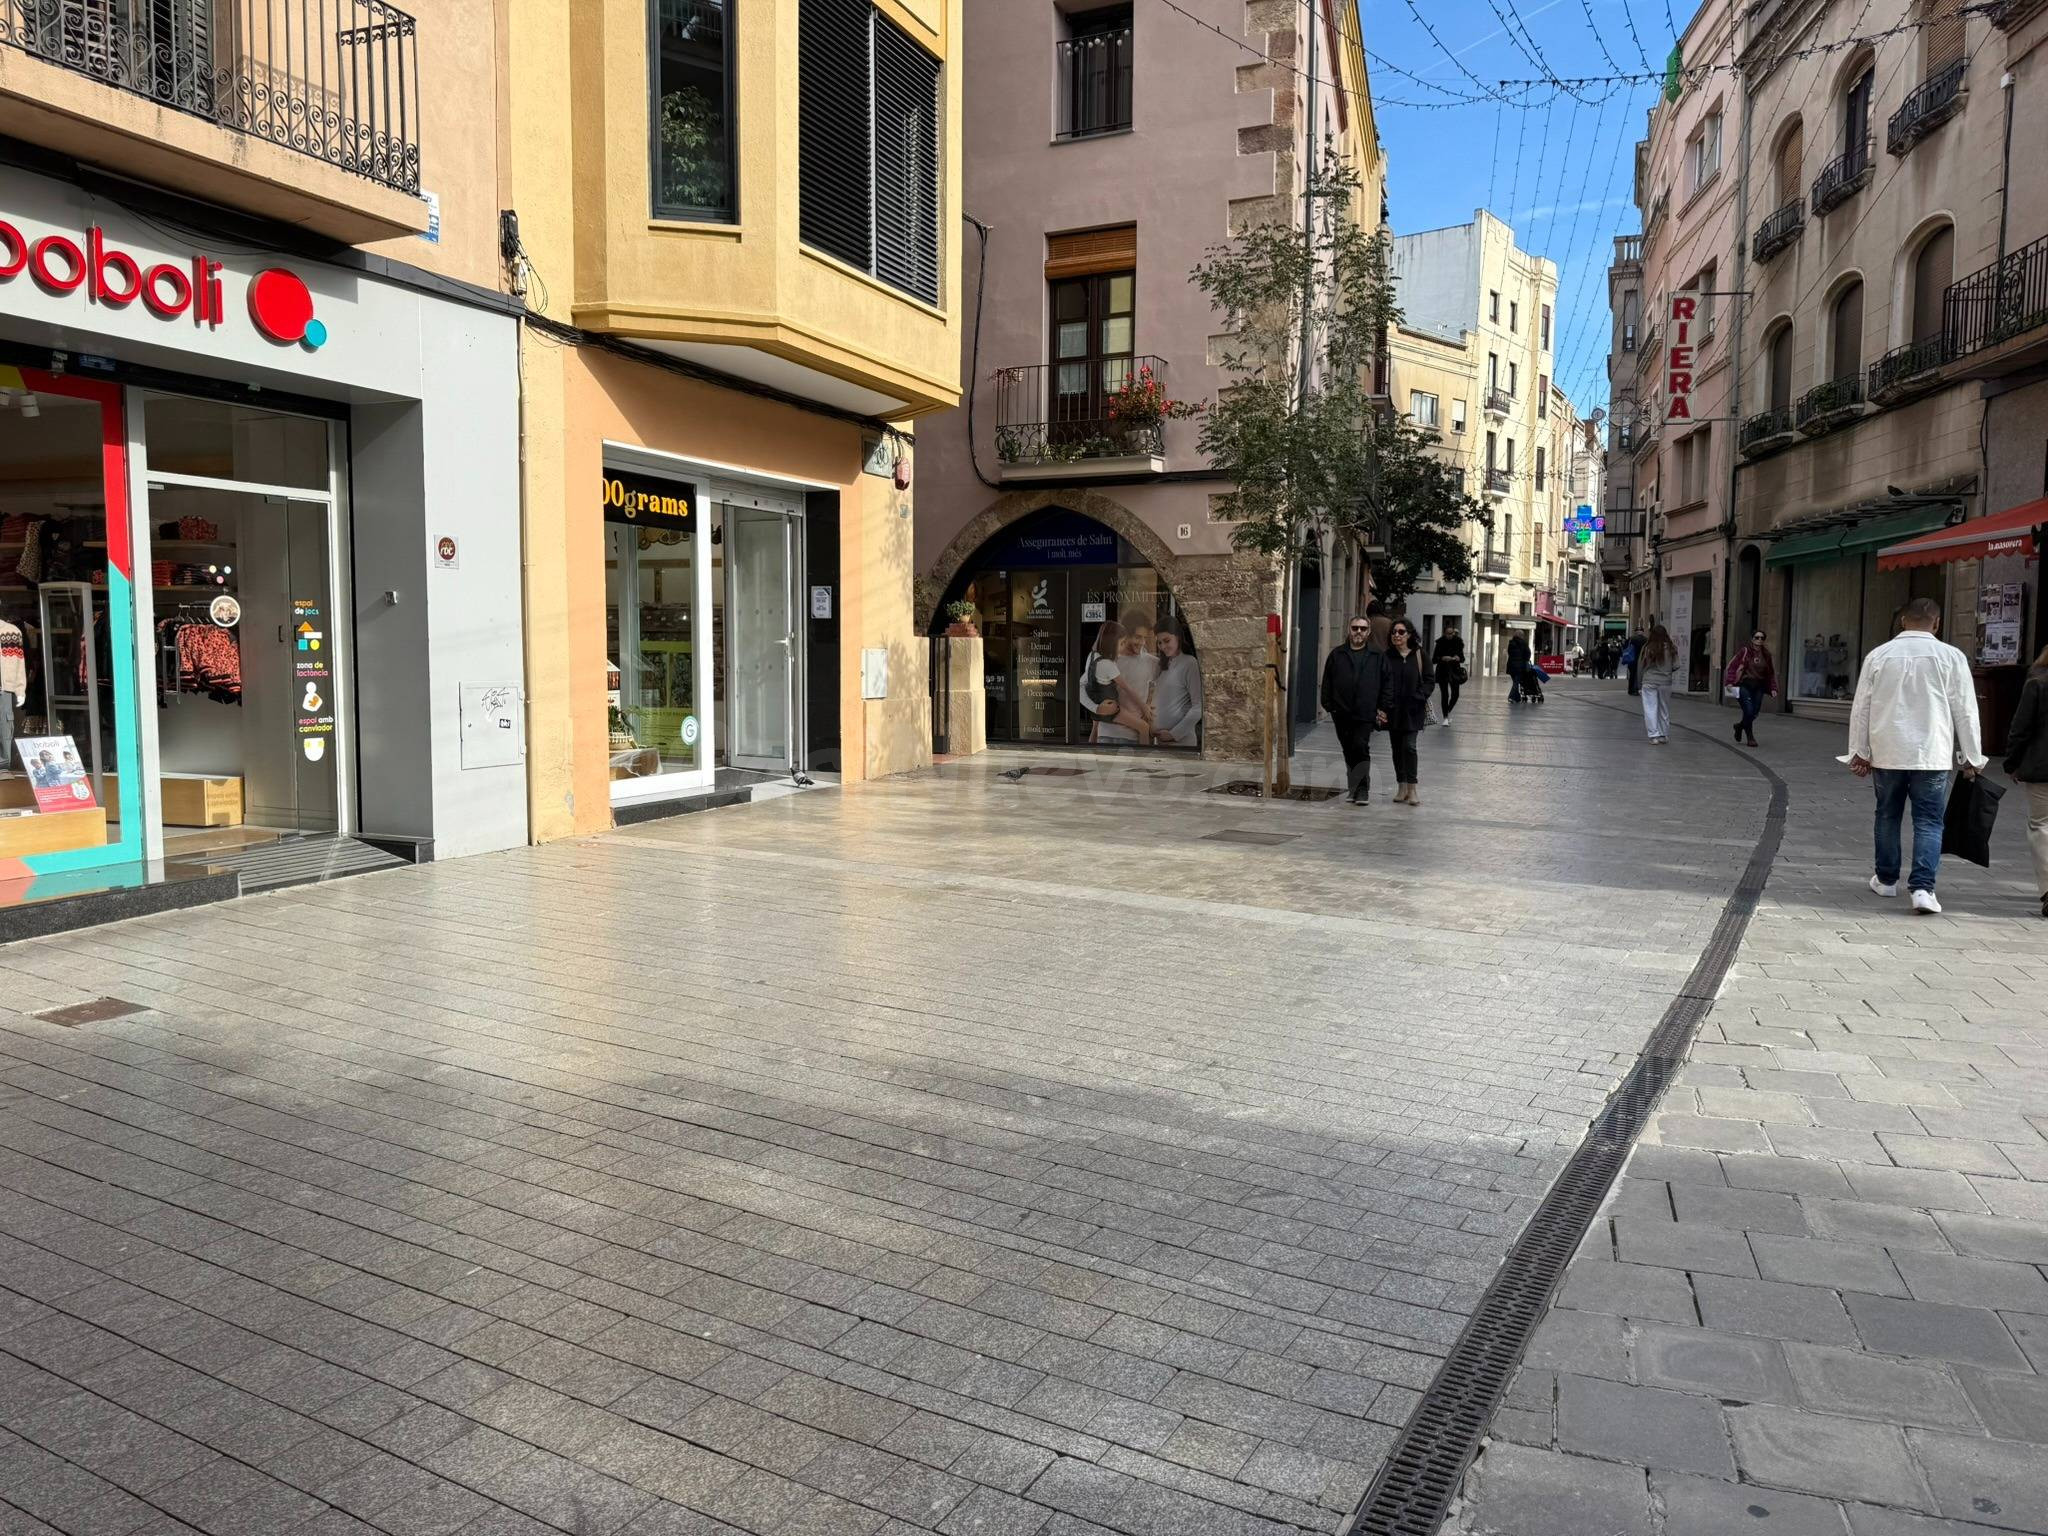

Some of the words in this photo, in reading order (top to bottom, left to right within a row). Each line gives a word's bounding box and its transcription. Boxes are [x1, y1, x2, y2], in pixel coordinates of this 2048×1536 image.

[1667, 297, 1697, 419] RIERA
[1180, 527, 1189, 537] 16
[1078, 535, 1088, 546] de
[1089, 534, 1113, 545] Salut
[294, 600, 313, 608] espai
[294, 607, 304, 615] de
[304, 608, 319, 616] jocs
[1030, 642, 1052, 651] Dental
[314, 661, 324, 669] de
[298, 717, 317, 726] espai
[318, 715, 334, 724] amb
[298, 724, 333, 733] canviador
